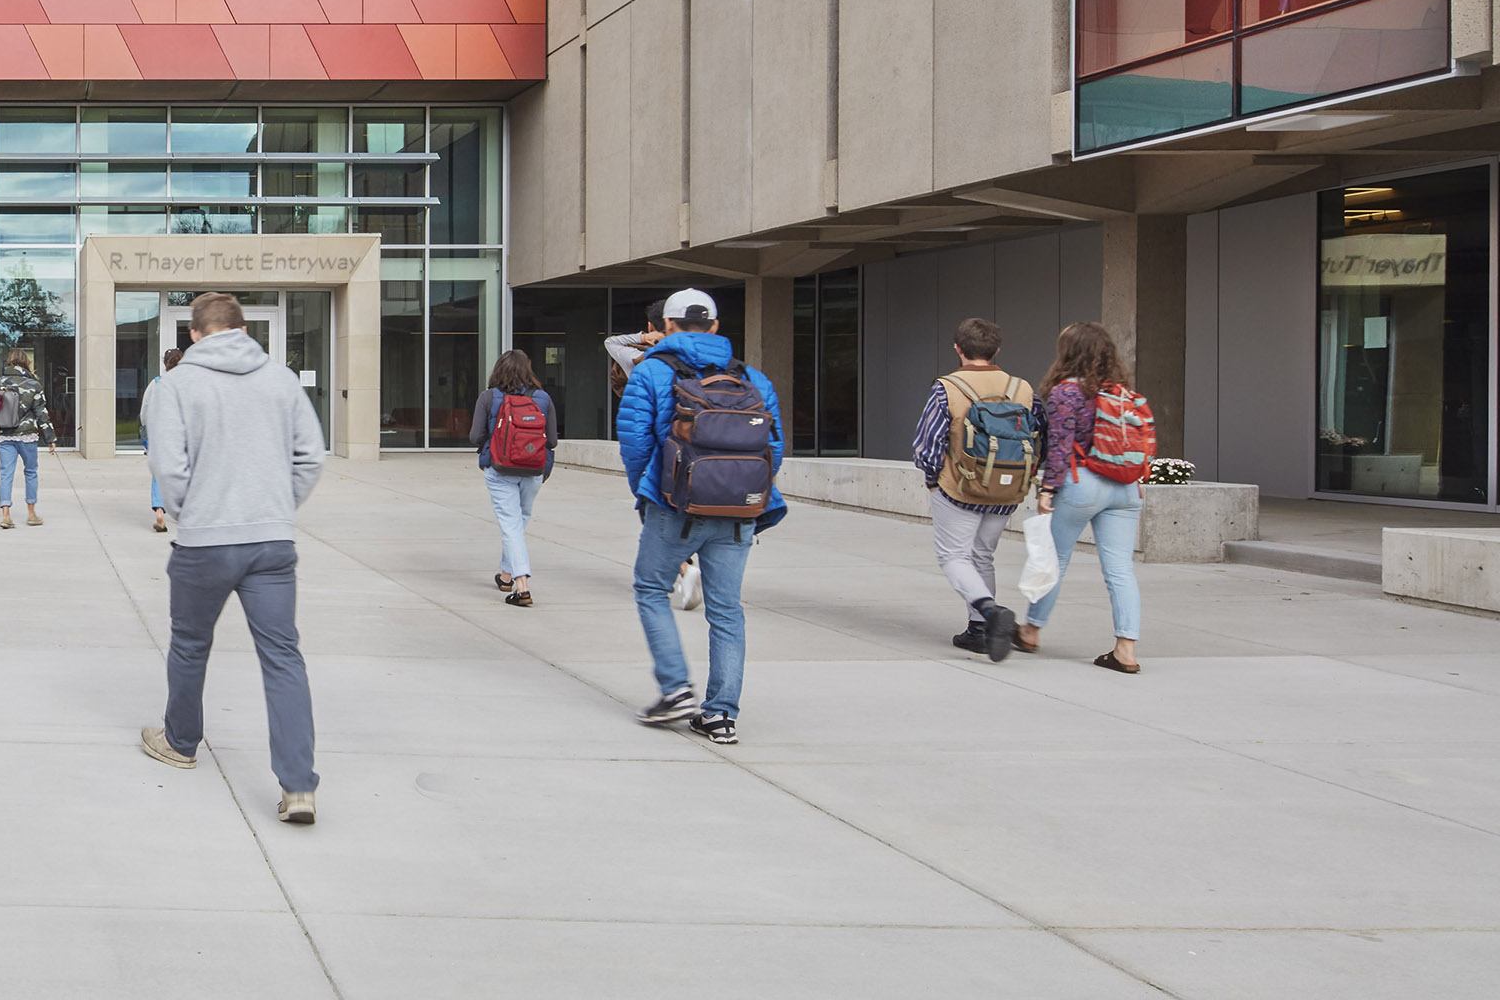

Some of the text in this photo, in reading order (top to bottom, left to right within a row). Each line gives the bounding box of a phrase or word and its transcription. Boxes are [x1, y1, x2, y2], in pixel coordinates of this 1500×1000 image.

[109, 252, 362, 274] R. Thayer Tutt Entryway
